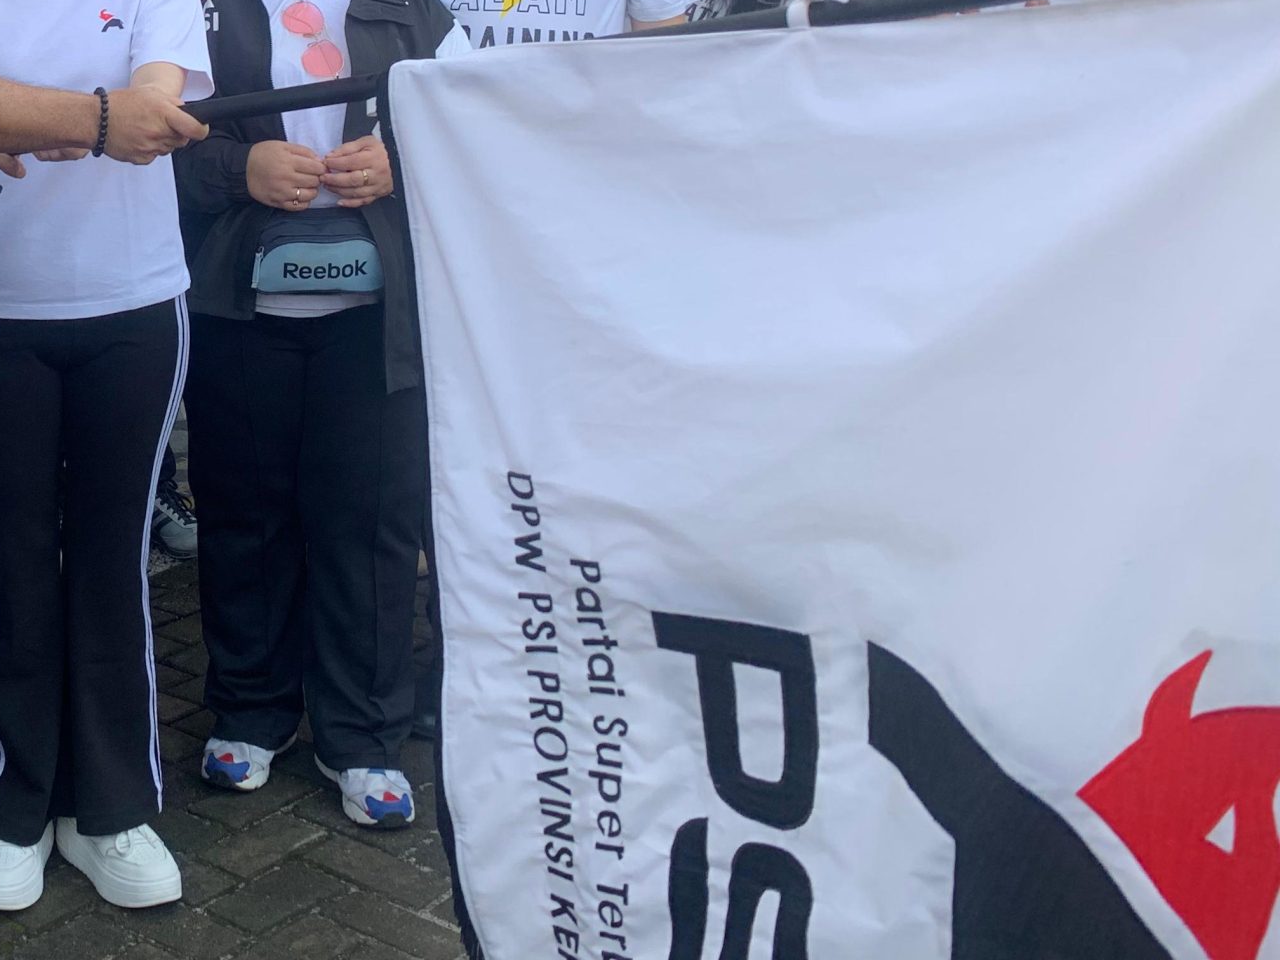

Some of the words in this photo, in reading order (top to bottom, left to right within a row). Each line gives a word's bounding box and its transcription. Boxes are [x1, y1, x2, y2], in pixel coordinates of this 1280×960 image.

[283, 260, 368, 279] Reebok
[507, 471, 547, 573] DPW
[518, 592, 559, 653] PSI
[527, 670, 575, 882] PROVINSI
[588, 715, 629, 860] Super
